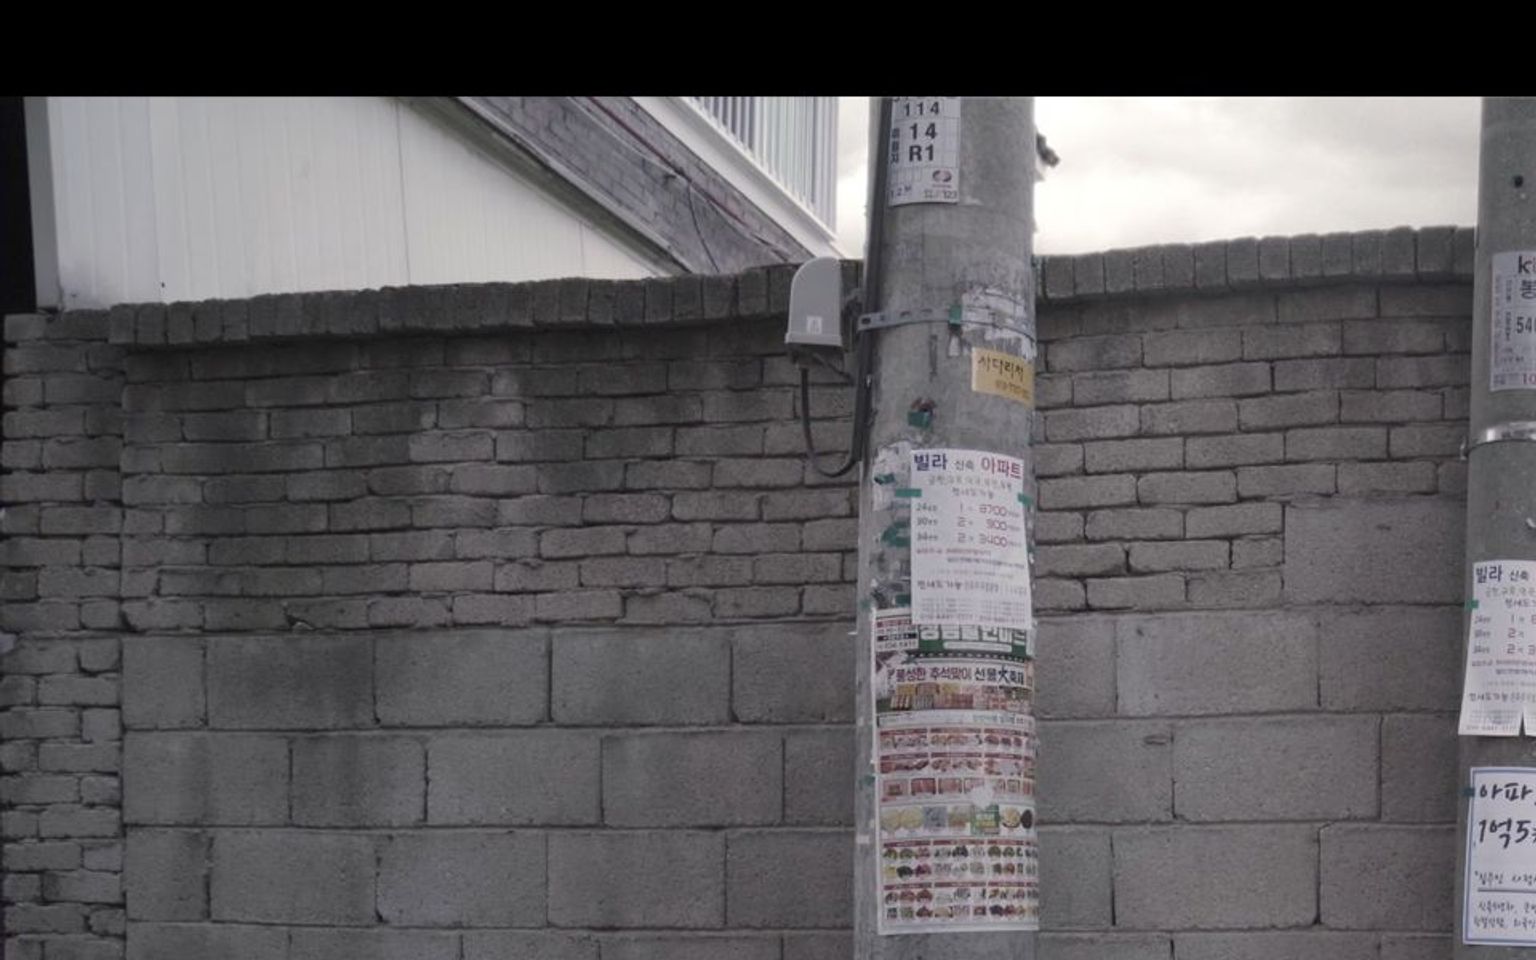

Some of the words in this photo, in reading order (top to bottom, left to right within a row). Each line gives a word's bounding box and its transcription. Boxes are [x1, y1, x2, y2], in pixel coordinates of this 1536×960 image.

[904, 101, 939, 116] 114
[909, 122, 938, 140] 14
[909, 144, 934, 162] R1
[913, 453, 948, 472] 빌라
[981, 457, 1022, 480] 아파트
[1476, 565, 1503, 584] 빌라
